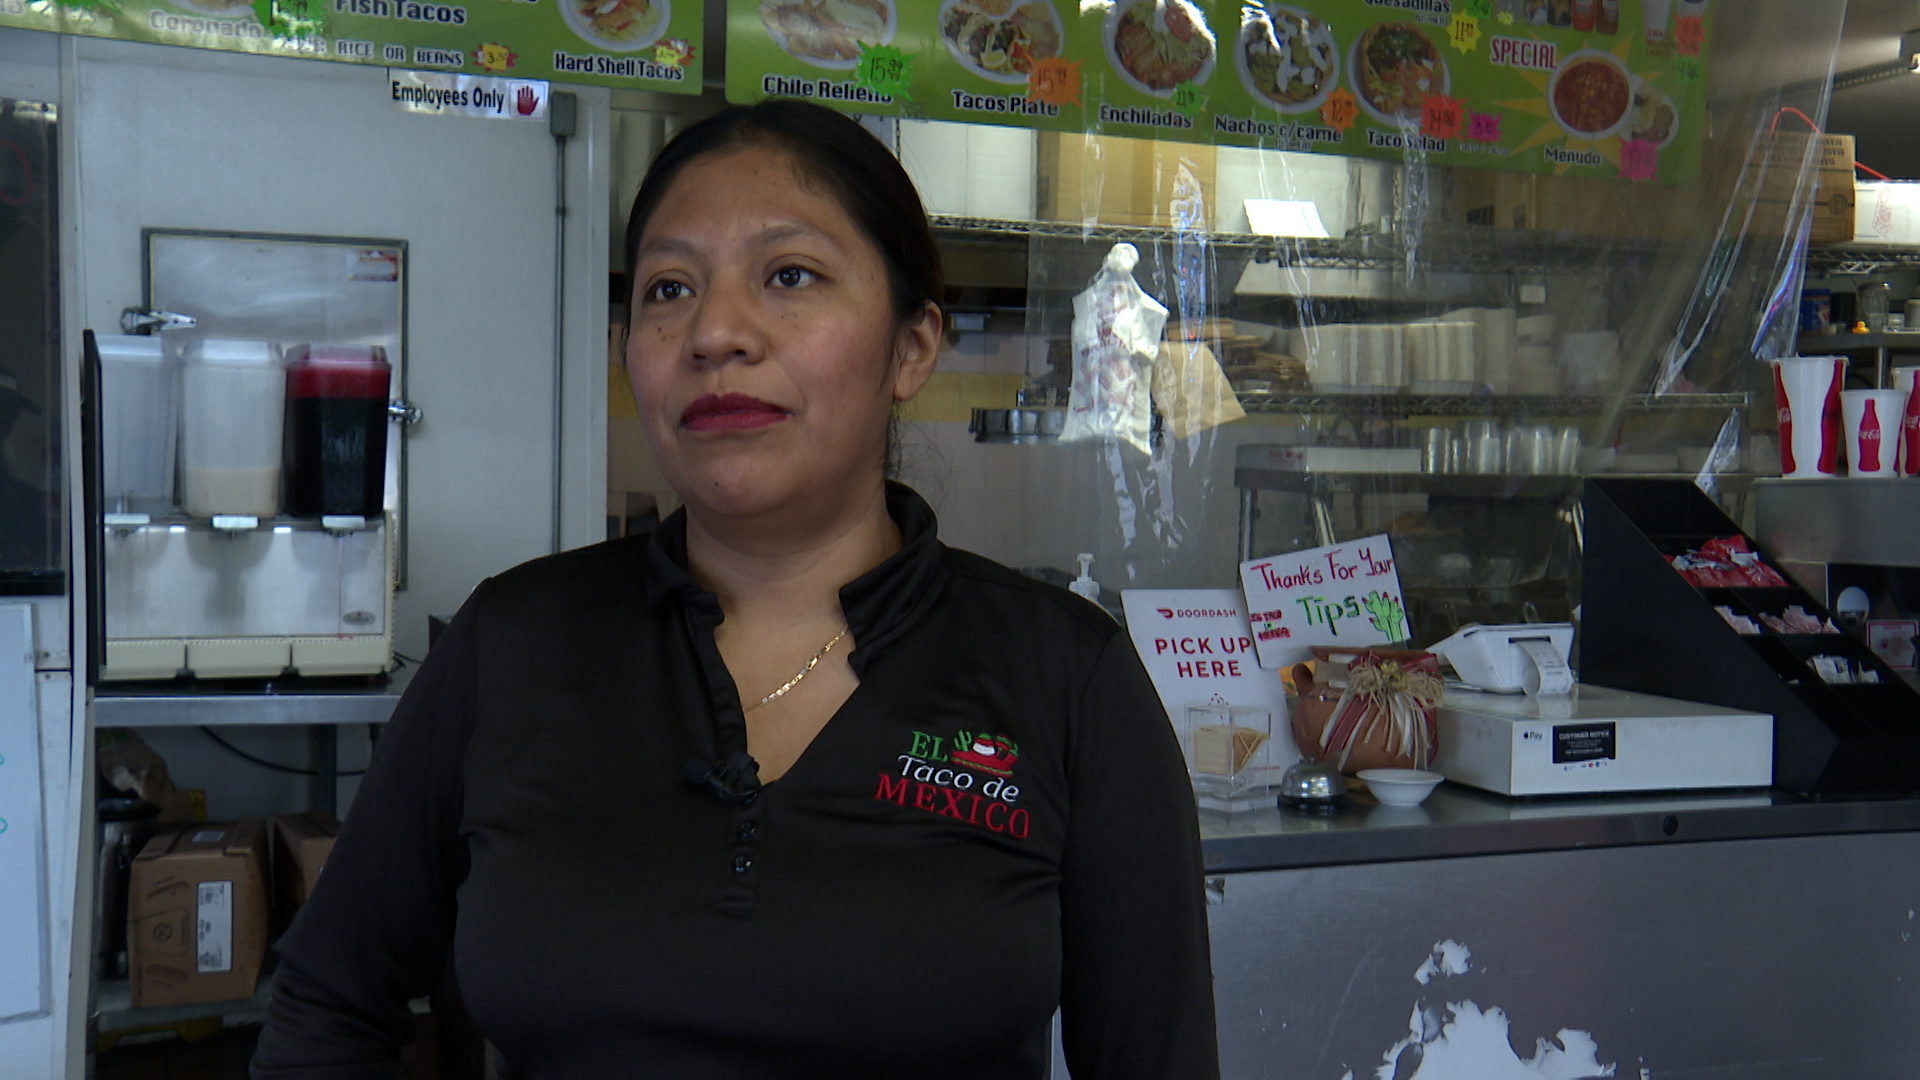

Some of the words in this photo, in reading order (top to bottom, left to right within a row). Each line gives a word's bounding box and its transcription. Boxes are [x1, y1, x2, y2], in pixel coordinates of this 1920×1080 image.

[394, 0, 465, 24] Tacos
[338, 41, 373, 56] RICE
[385, 47, 404, 60] OR
[416, 49, 462, 65] BEANS
[1491, 38, 1557, 69] SPECIAL
[555, 54, 593, 73] Hard
[598, 57, 635, 76] Shell
[639, 63, 682, 80] Tacos
[391, 81, 468, 108] Employees
[472, 86, 504, 113] Only
[764, 77, 813, 96] Chile
[952, 91, 1005, 112] Tacos
[1100, 104, 1192, 128] Enchiladas
[1214, 116, 1275, 136] Nachos
[1279, 120, 1341, 142] c/carne
[1367, 130, 1400, 148] Taco
[1406, 134, 1445, 152] Salad
[1545, 147, 1601, 164] Menudo
[1250, 562, 1323, 592] Thanks
[1324, 549, 1358, 580] For
[1358, 547, 1393, 576] Your
[1177, 609, 1237, 618] DOORDASH
[1296, 595, 1360, 636] Tips
[1155, 637, 1213, 655] PICK
[1220, 637, 1251, 653] UP
[1177, 660, 1242, 678] HERE
[907, 730, 948, 762] EL
[898, 755, 974, 790] Taco
[982, 777, 1020, 803] de
[873, 773, 1031, 839] MEXICO
